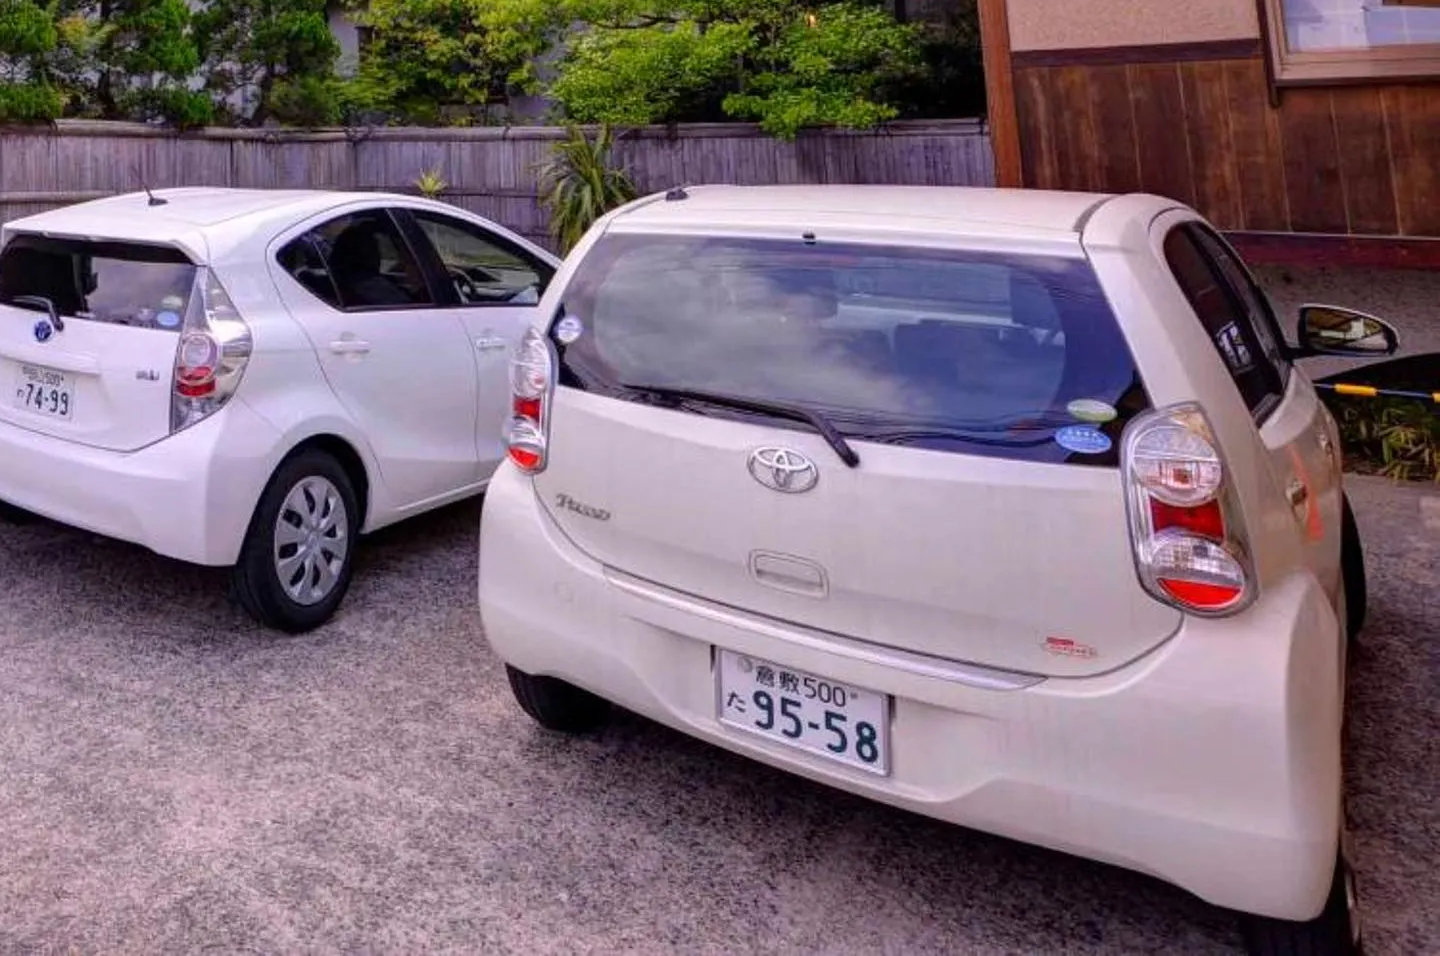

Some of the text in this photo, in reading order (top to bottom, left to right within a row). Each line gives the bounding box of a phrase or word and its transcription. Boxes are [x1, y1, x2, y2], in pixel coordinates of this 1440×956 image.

[804, 677, 846, 707] 500
[727, 690, 879, 763] た 95-58
